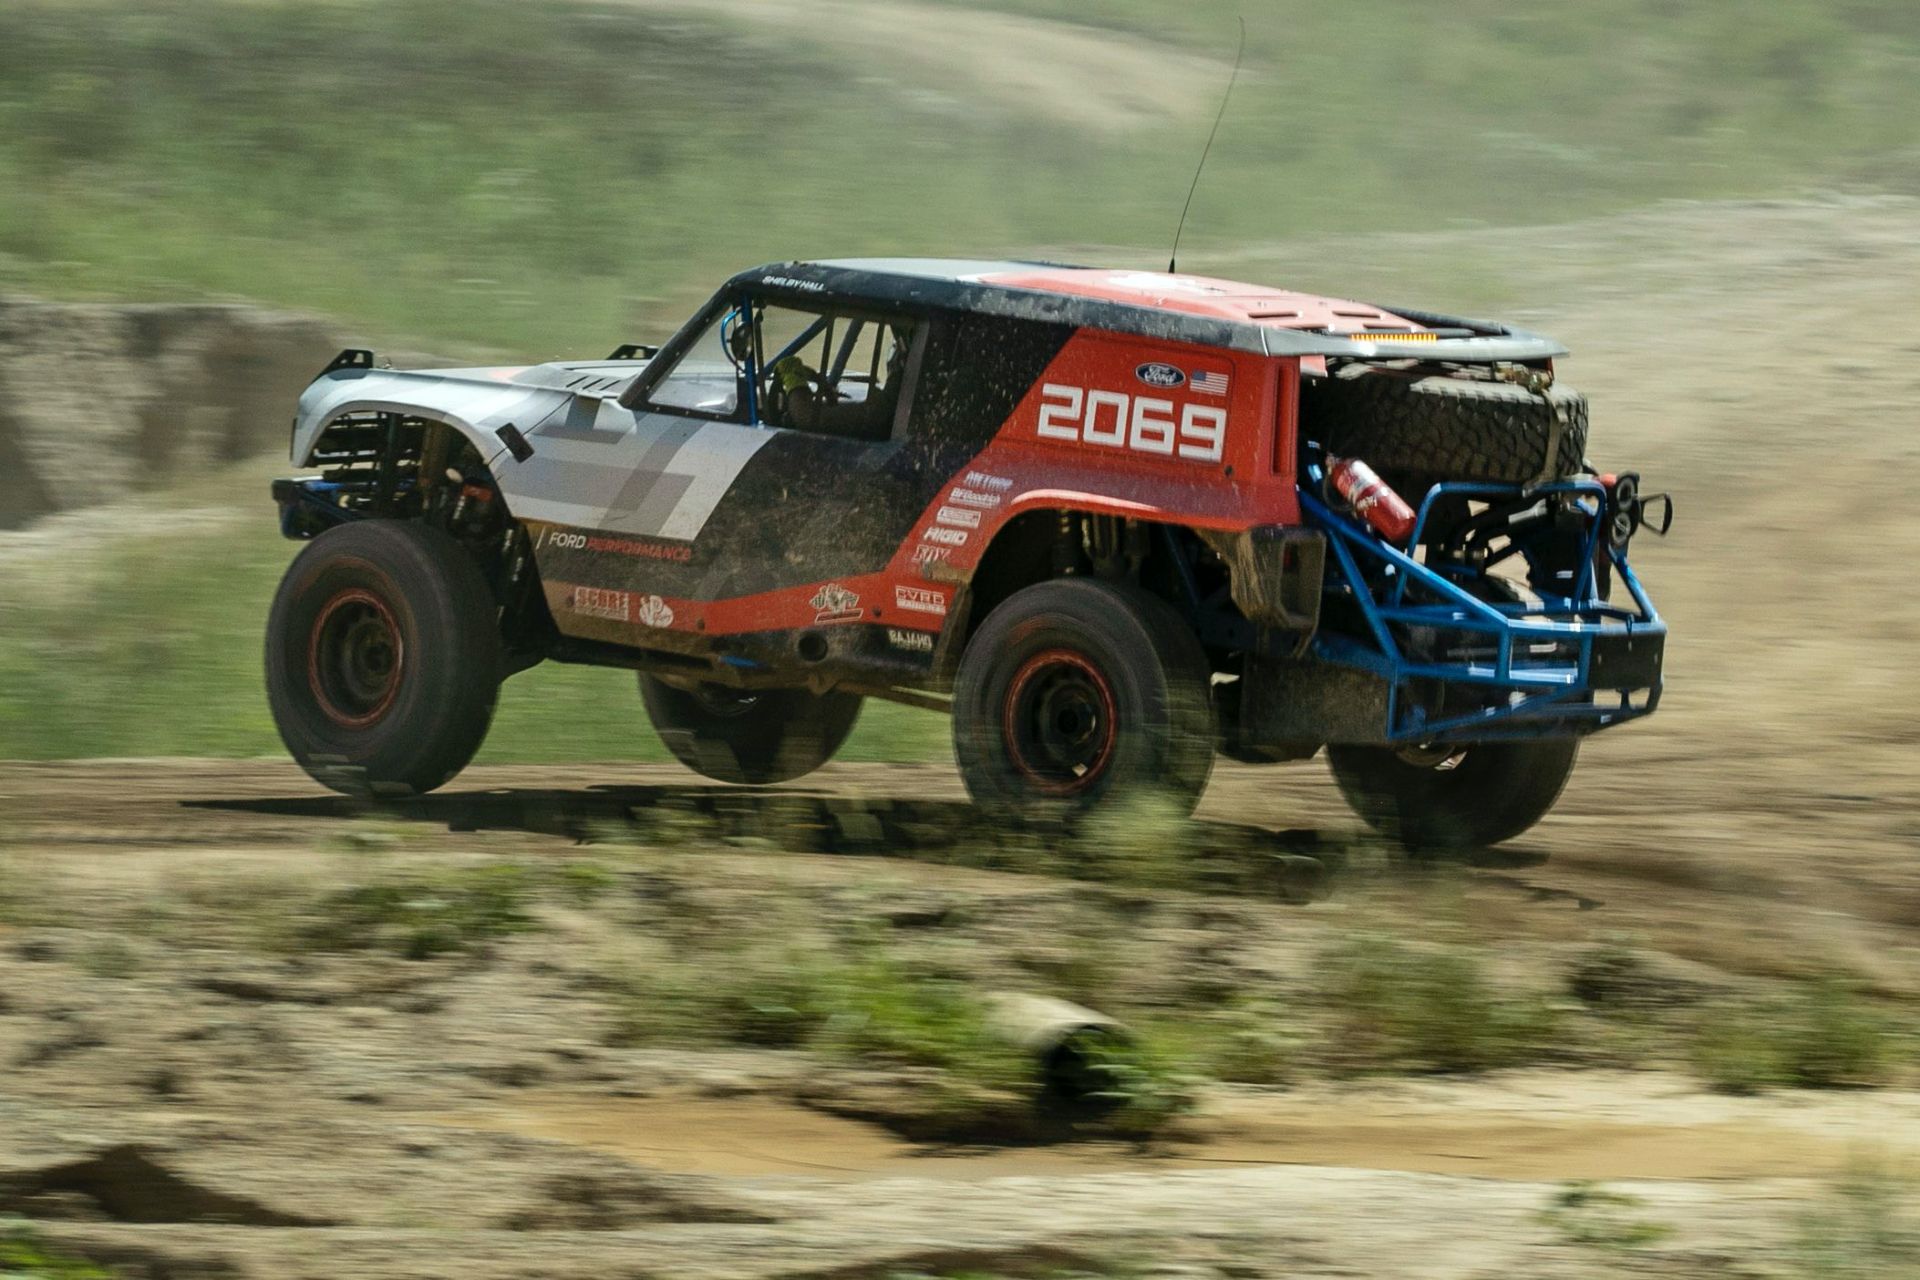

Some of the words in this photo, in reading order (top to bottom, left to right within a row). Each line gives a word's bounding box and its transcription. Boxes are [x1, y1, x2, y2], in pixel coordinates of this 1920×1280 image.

[762, 275, 801, 288] SHELBY
[799, 280, 825, 291] HALL
[1144, 364, 1177, 385] Ford
[1037, 383, 1227, 465] 2069
[548, 531, 587, 549] FORD
[587, 536, 692, 562] PERFORMANCE
[924, 526, 968, 547] RIGID
